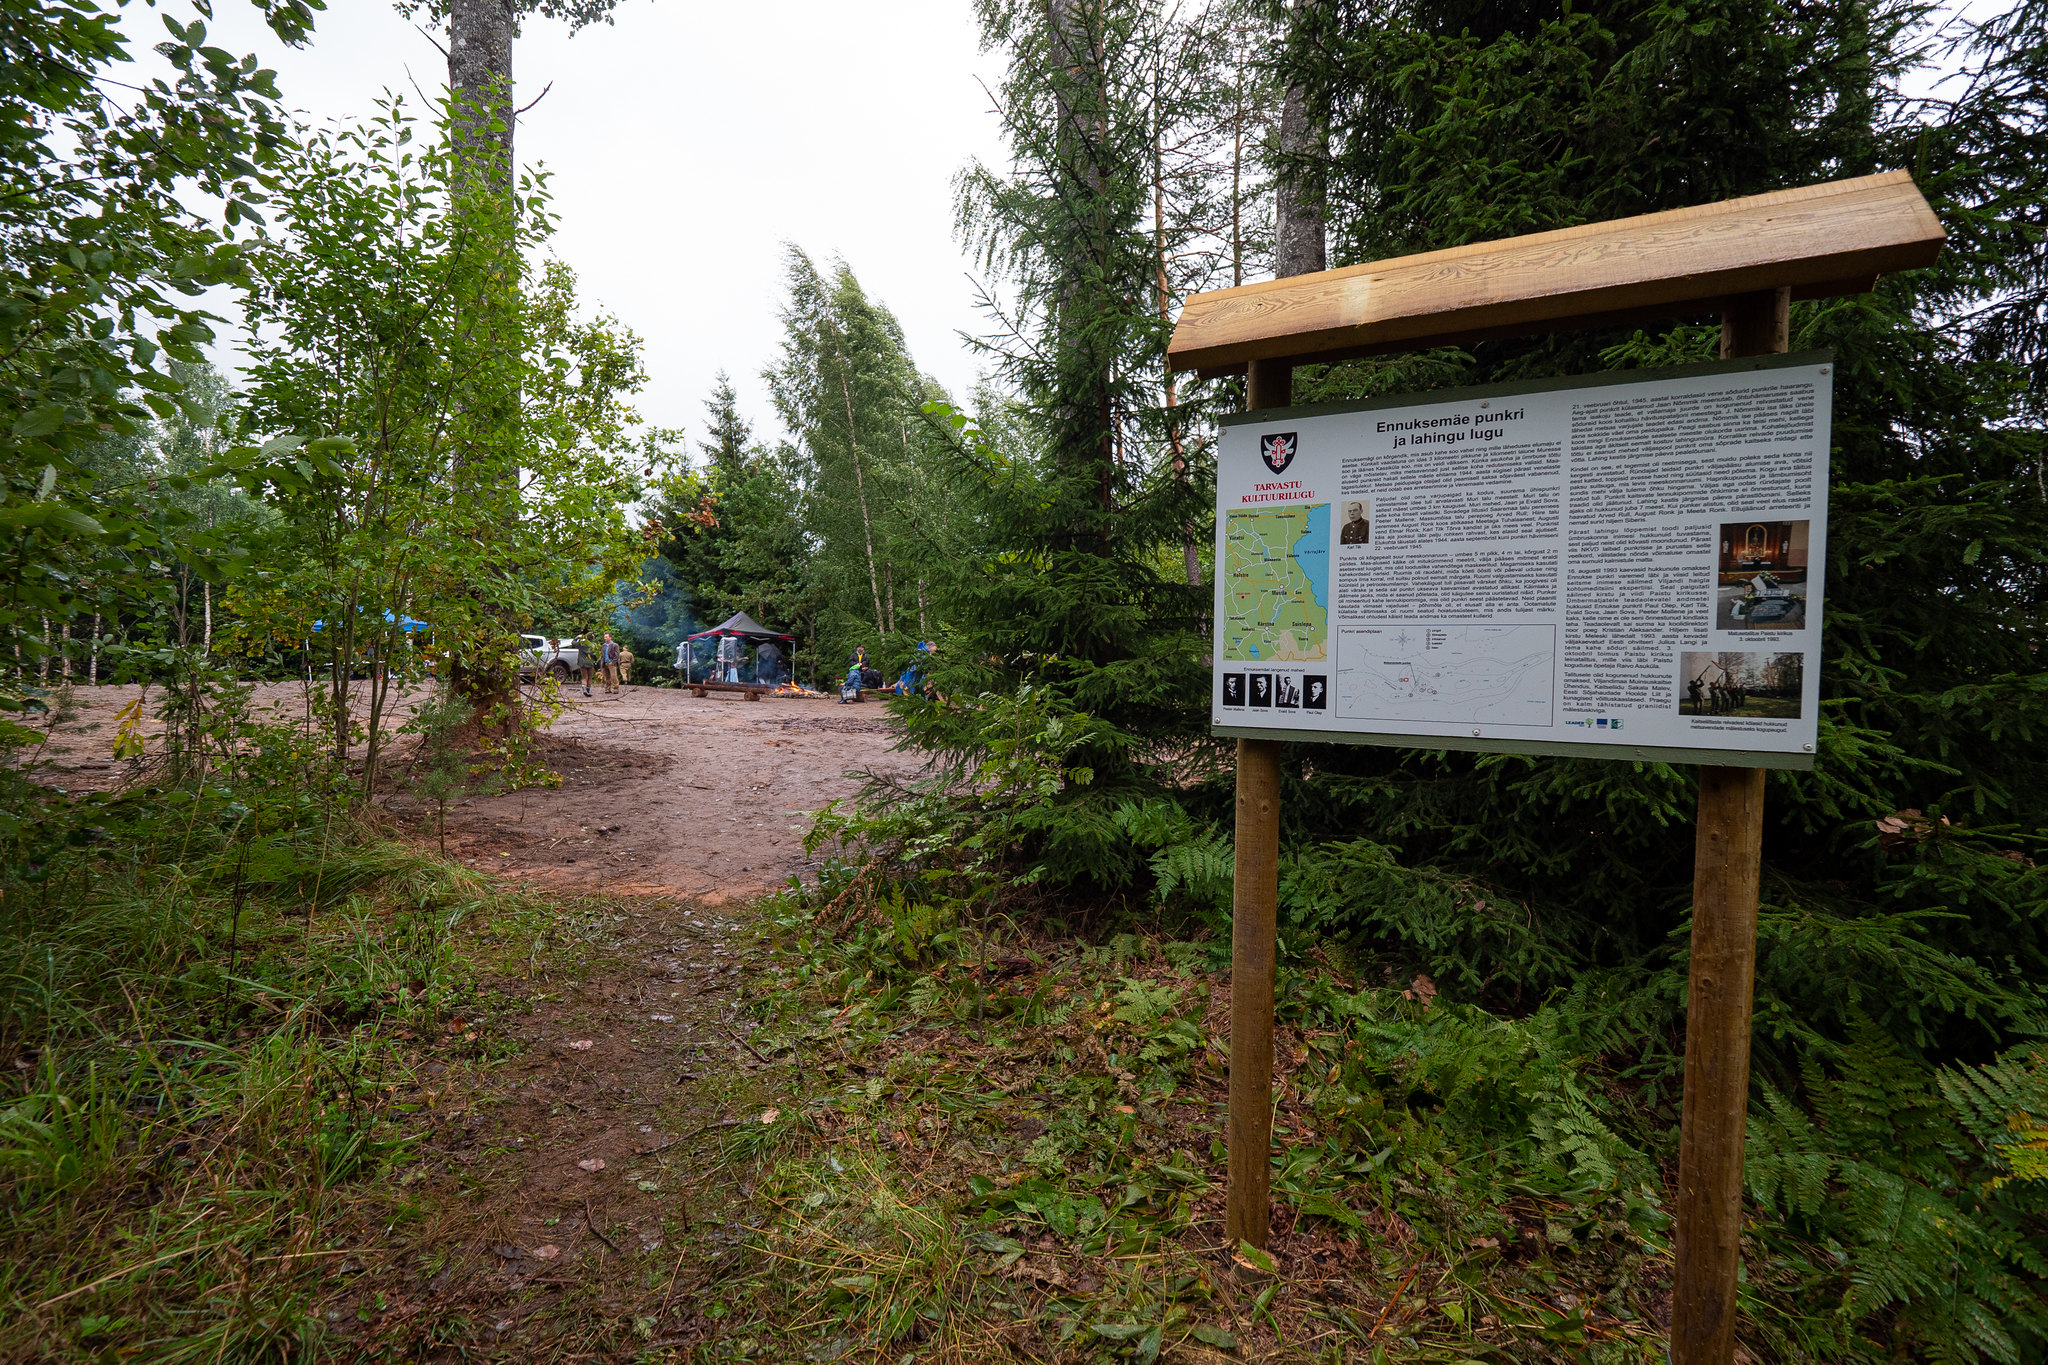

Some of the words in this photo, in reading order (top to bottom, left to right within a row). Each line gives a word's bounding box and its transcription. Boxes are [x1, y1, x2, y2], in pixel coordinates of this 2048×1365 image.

[1376, 414, 1470, 432] Ennuksemäe
[1475, 408, 1524, 426] punkri
[1393, 436, 1406, 449] ja
[1411, 432, 1465, 445] lahingu
[1470, 428, 1503, 440] lugu
[1254, 481, 1302, 491] TARVASTU
[1242, 491, 1315, 503] KULTUURILUGU
